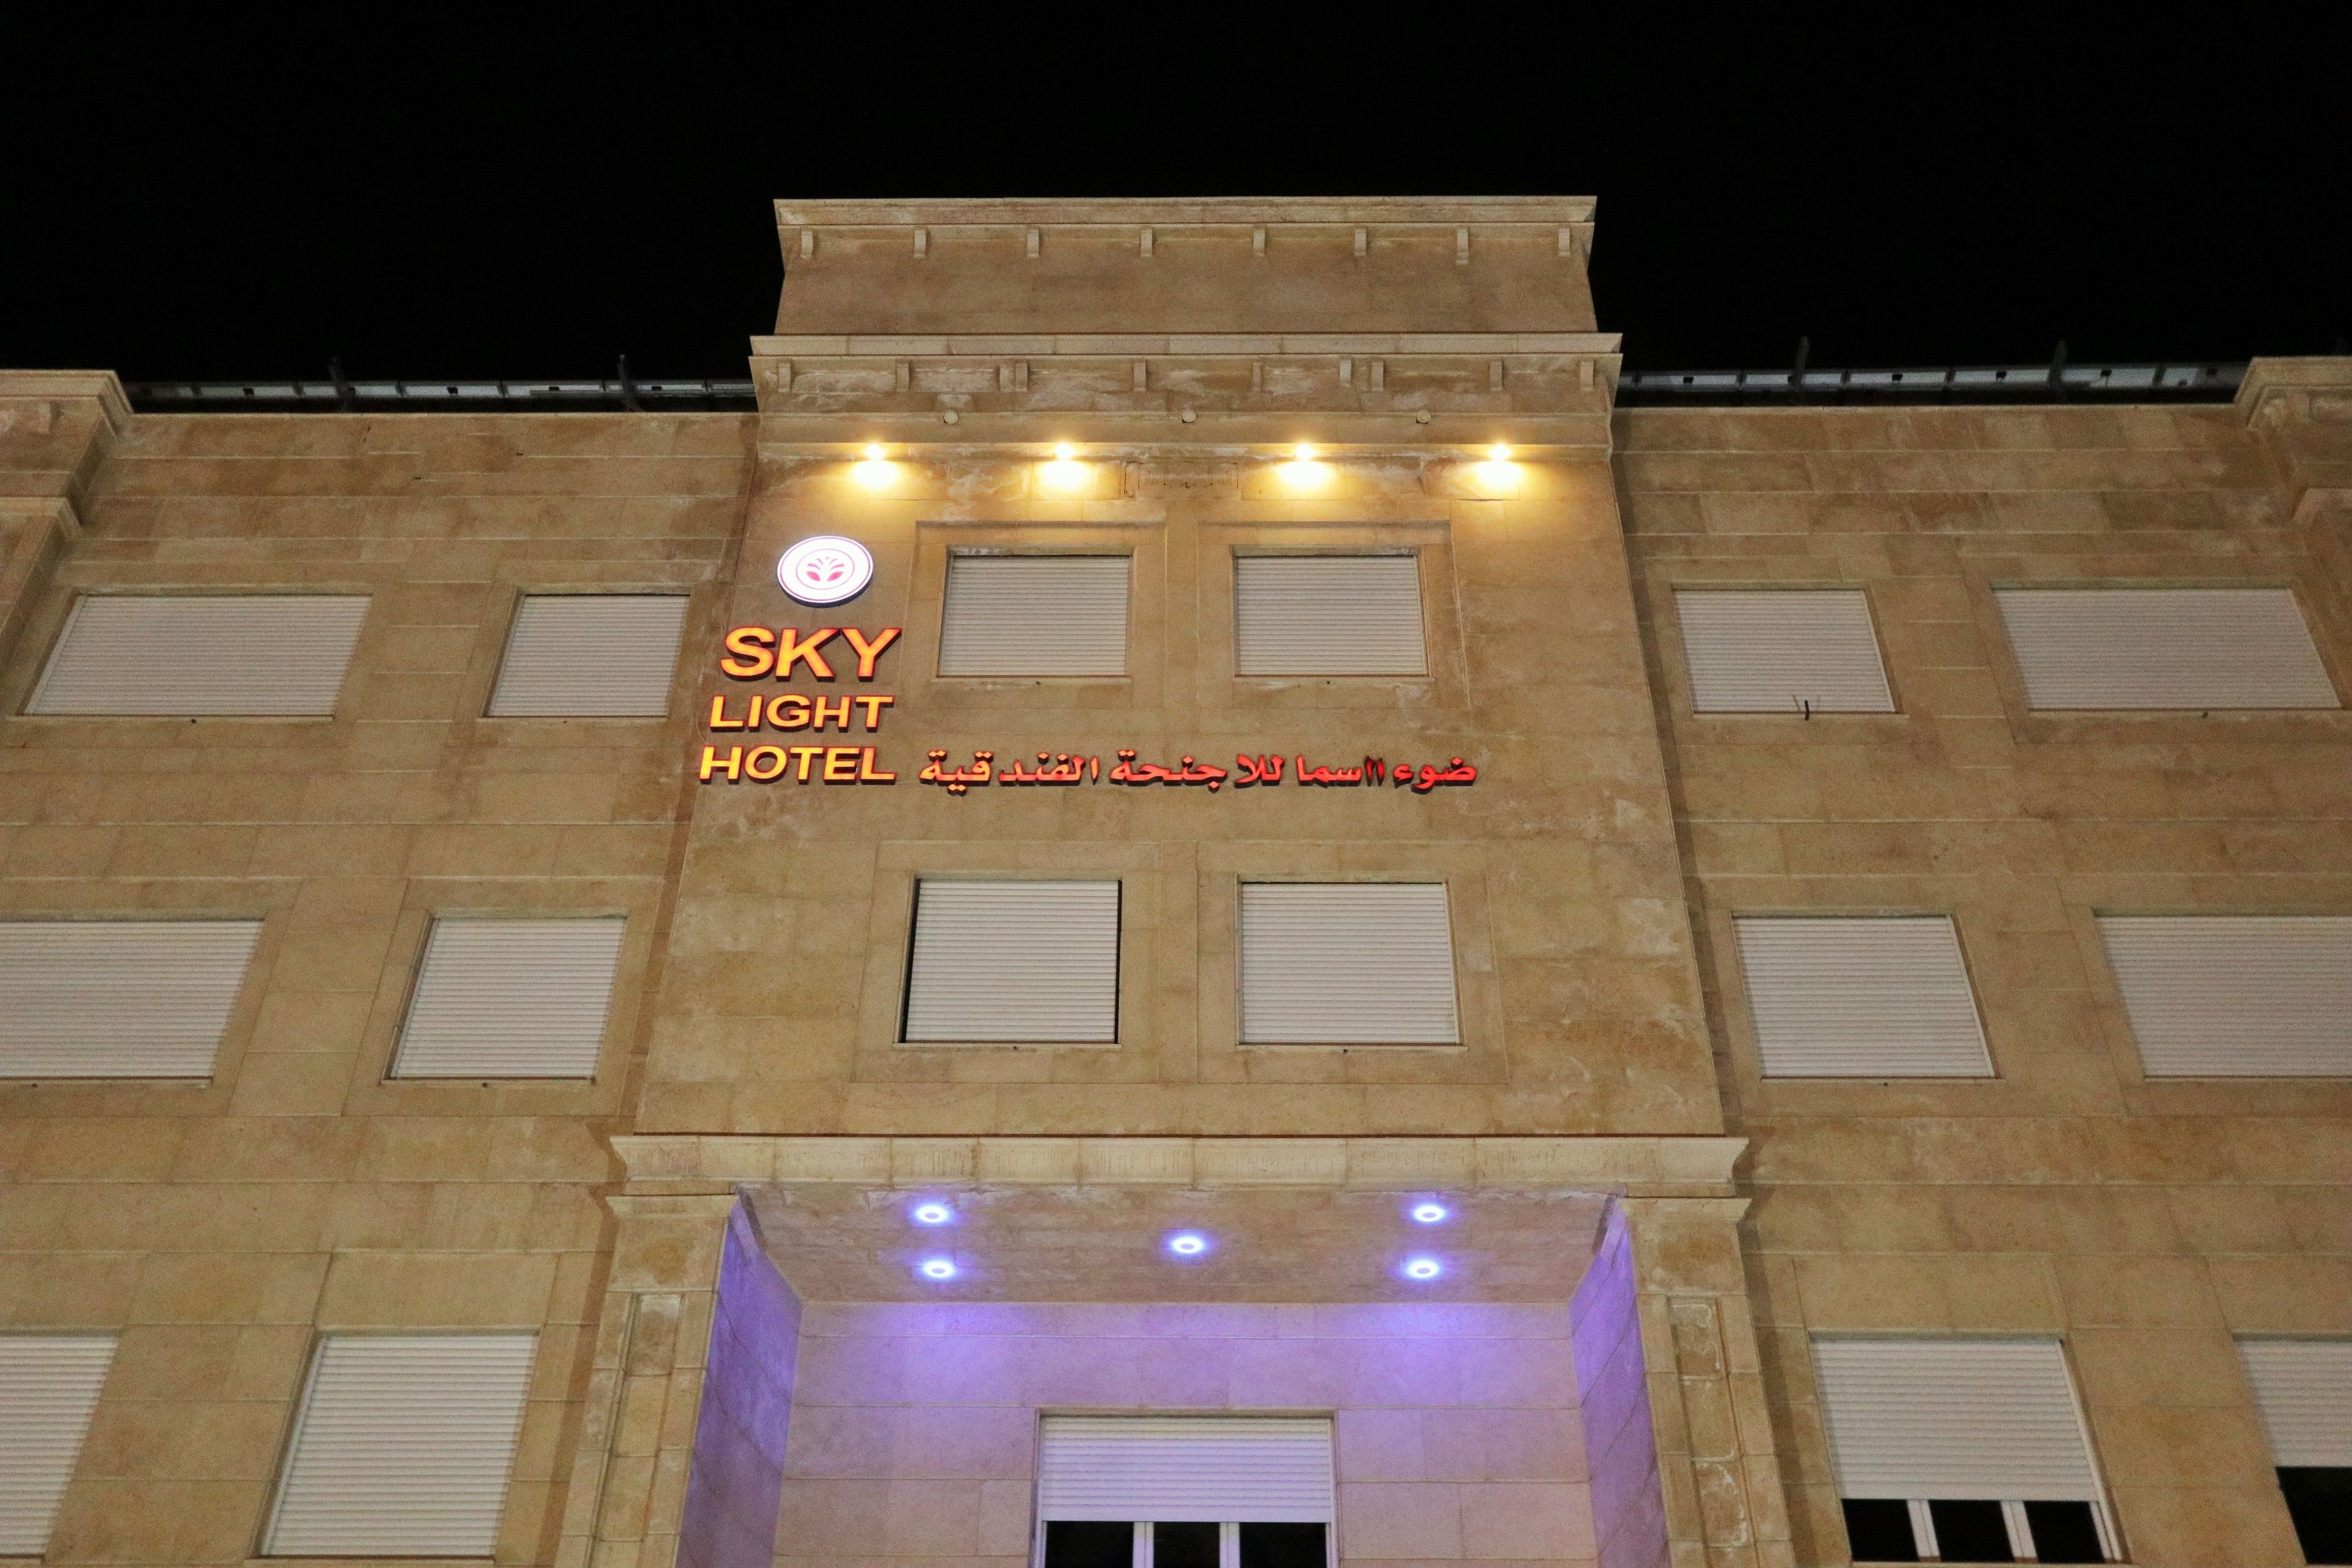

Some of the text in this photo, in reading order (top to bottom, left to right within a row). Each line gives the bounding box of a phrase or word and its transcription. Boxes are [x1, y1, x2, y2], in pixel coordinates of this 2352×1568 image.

[720, 627, 901, 680] SKY
[709, 695, 894, 731] LIGHT
[699, 745, 895, 782] HOTEL
[919, 749, 1099, 794] الفندقية
[1393, 756, 1477, 793] ضوء
